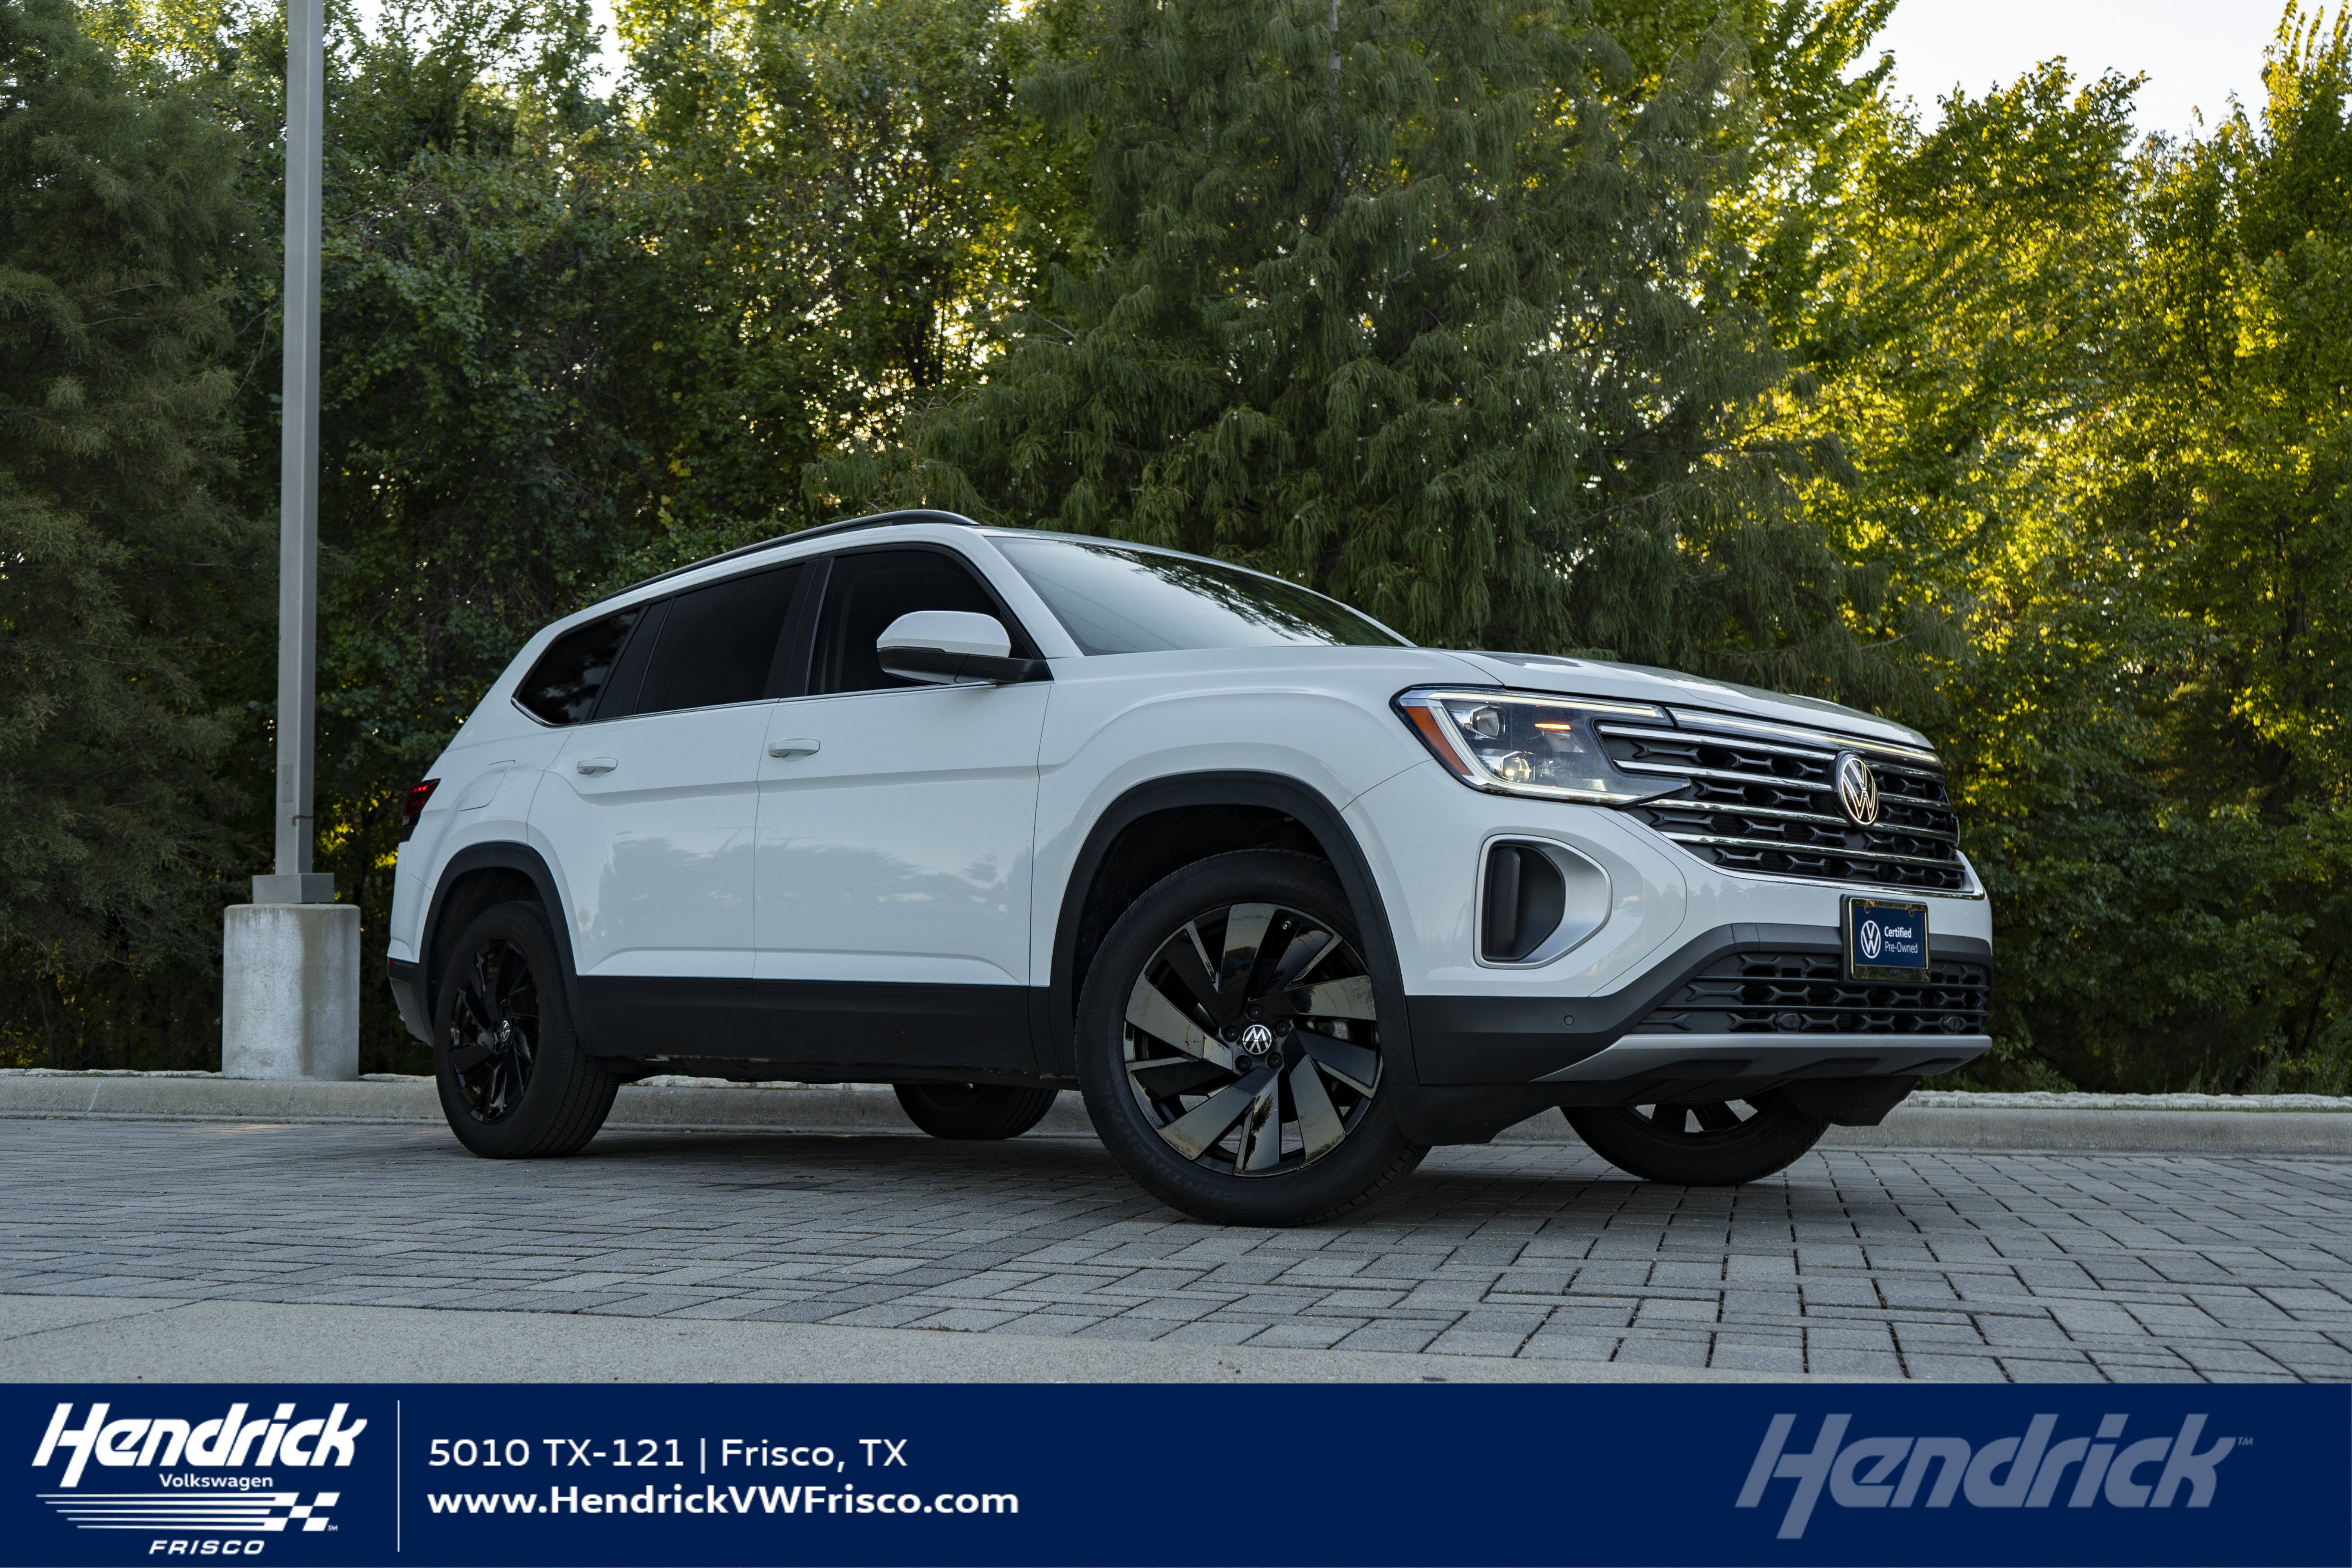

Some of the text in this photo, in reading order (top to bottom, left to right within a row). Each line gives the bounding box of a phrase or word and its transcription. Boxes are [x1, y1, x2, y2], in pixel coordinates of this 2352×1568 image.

[1884, 926, 1912, 938] Certified
[1861, 921, 1880, 958] VW
[1885, 941, 1918, 953] Pre-Owned
